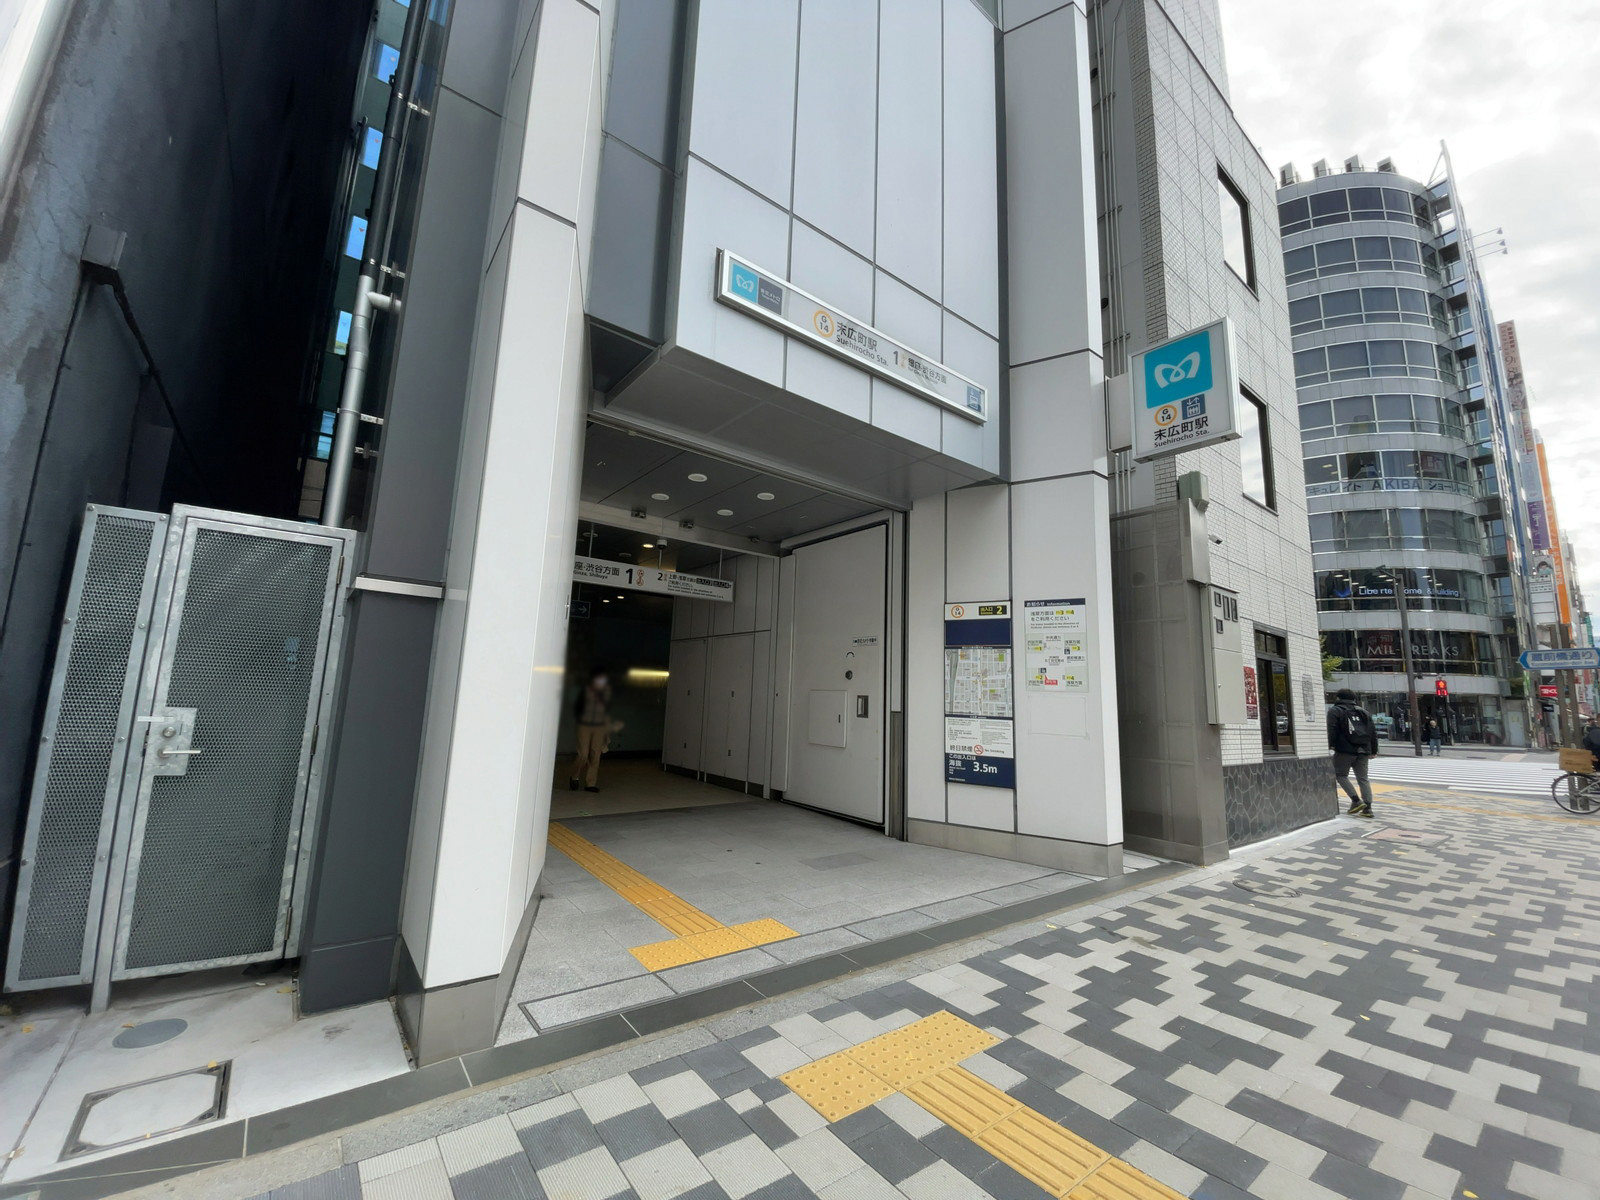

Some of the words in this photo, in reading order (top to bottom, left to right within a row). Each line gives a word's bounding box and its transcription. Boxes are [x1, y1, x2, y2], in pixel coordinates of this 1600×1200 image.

[821, 315, 827, 323] G
[819, 322, 829, 333] 14
[836, 321, 878, 352] 末広町駅
[836, 335, 875, 360] Suehirocho
[876, 354, 889, 367] Sta.
[893, 350, 899, 365] 1
[1161, 414, 1171, 422] 14
[1154, 416, 1209, 441] 末広町駅
[1154, 433, 1194, 448] Suehirocho
[1372, 479, 1421, 490] AKIBA
[625, 568, 633, 584] 1
[657, 572, 663, 581] 2
[996, 605, 1003, 615] 2
[949, 753, 977, 761] この出入口は
[973, 761, 998, 774] 3.5m
